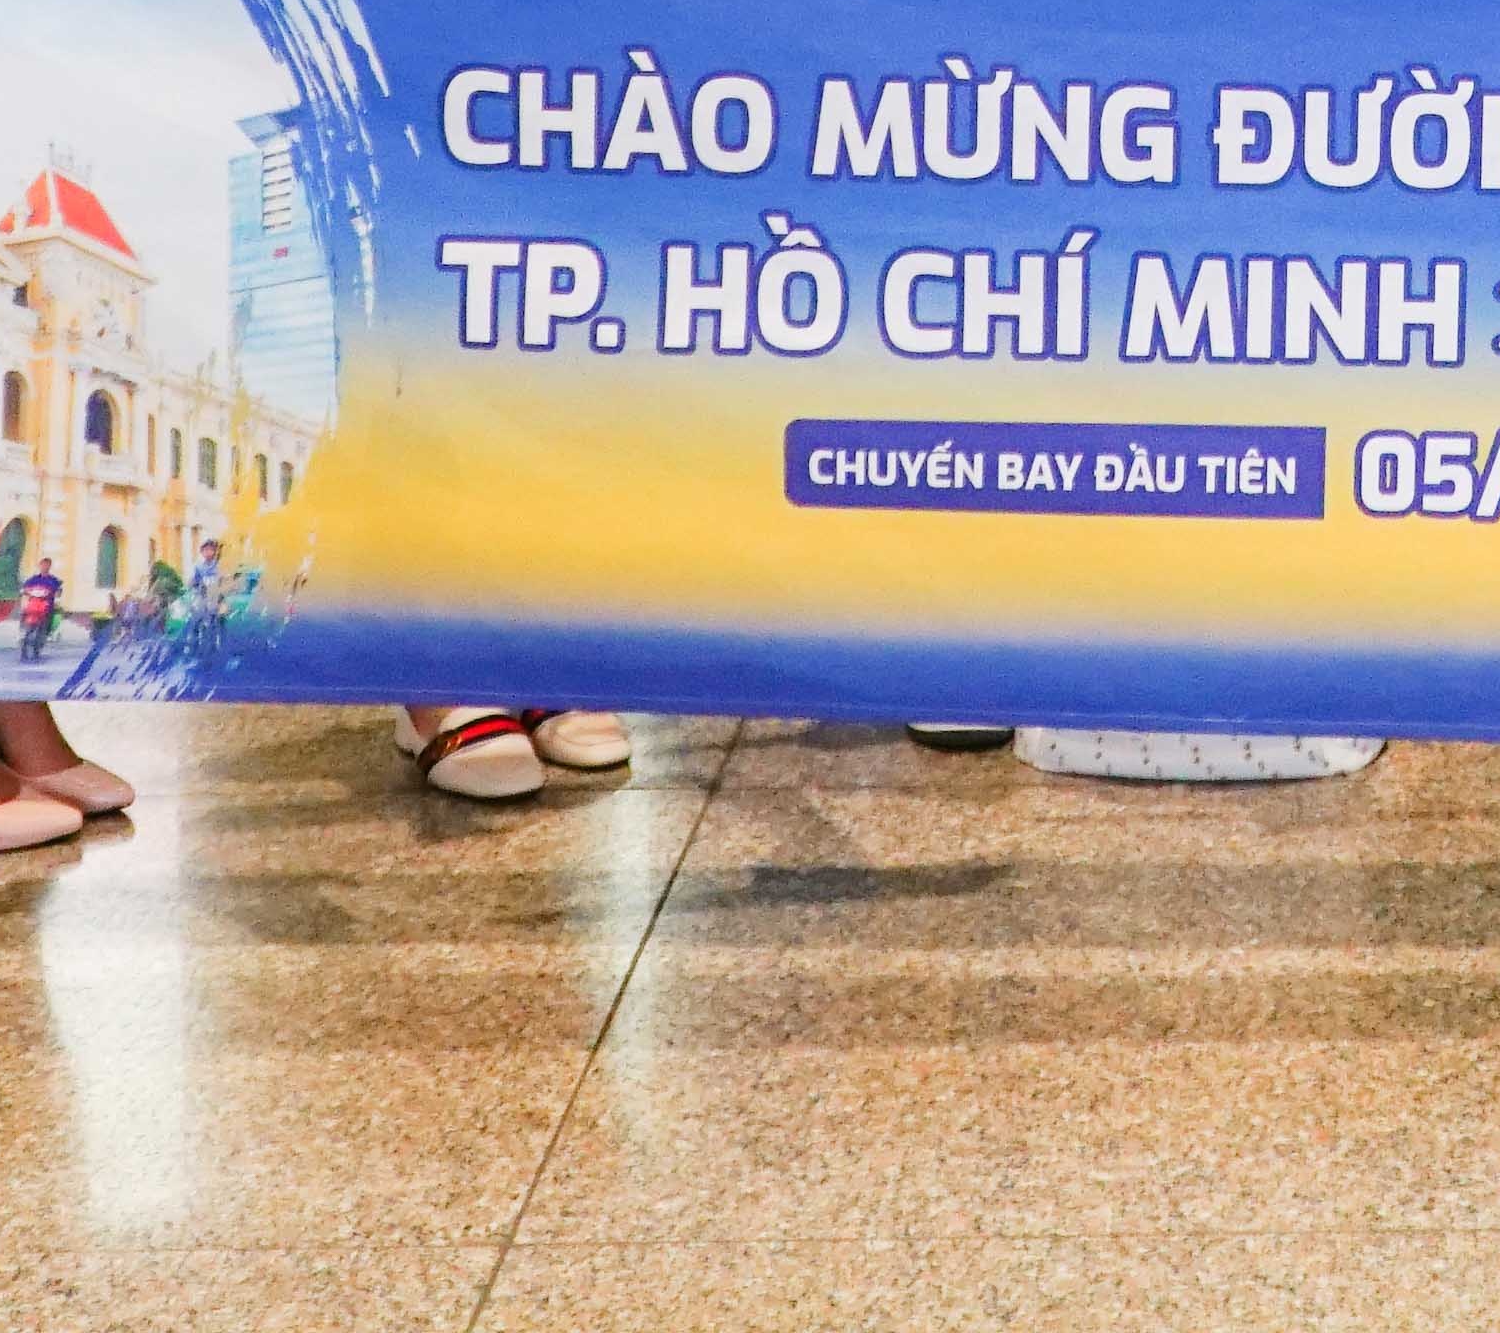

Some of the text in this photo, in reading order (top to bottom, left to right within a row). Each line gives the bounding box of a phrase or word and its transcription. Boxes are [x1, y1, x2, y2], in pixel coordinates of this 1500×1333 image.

[441, 50, 775, 175] CHÀO
[808, 55, 1177, 184] MỪNG
[438, 238, 627, 351] TP.
[659, 210, 847, 356] HỒ
[882, 229, 1095, 359] CHÍ
[1122, 252, 1464, 363] MINH
[807, 439, 985, 491] CHUYẾN
[998, 452, 1080, 493] BAY
[1093, 440, 1186, 495] ĐẦU
[1196, 448, 1297, 497] TIÊN
